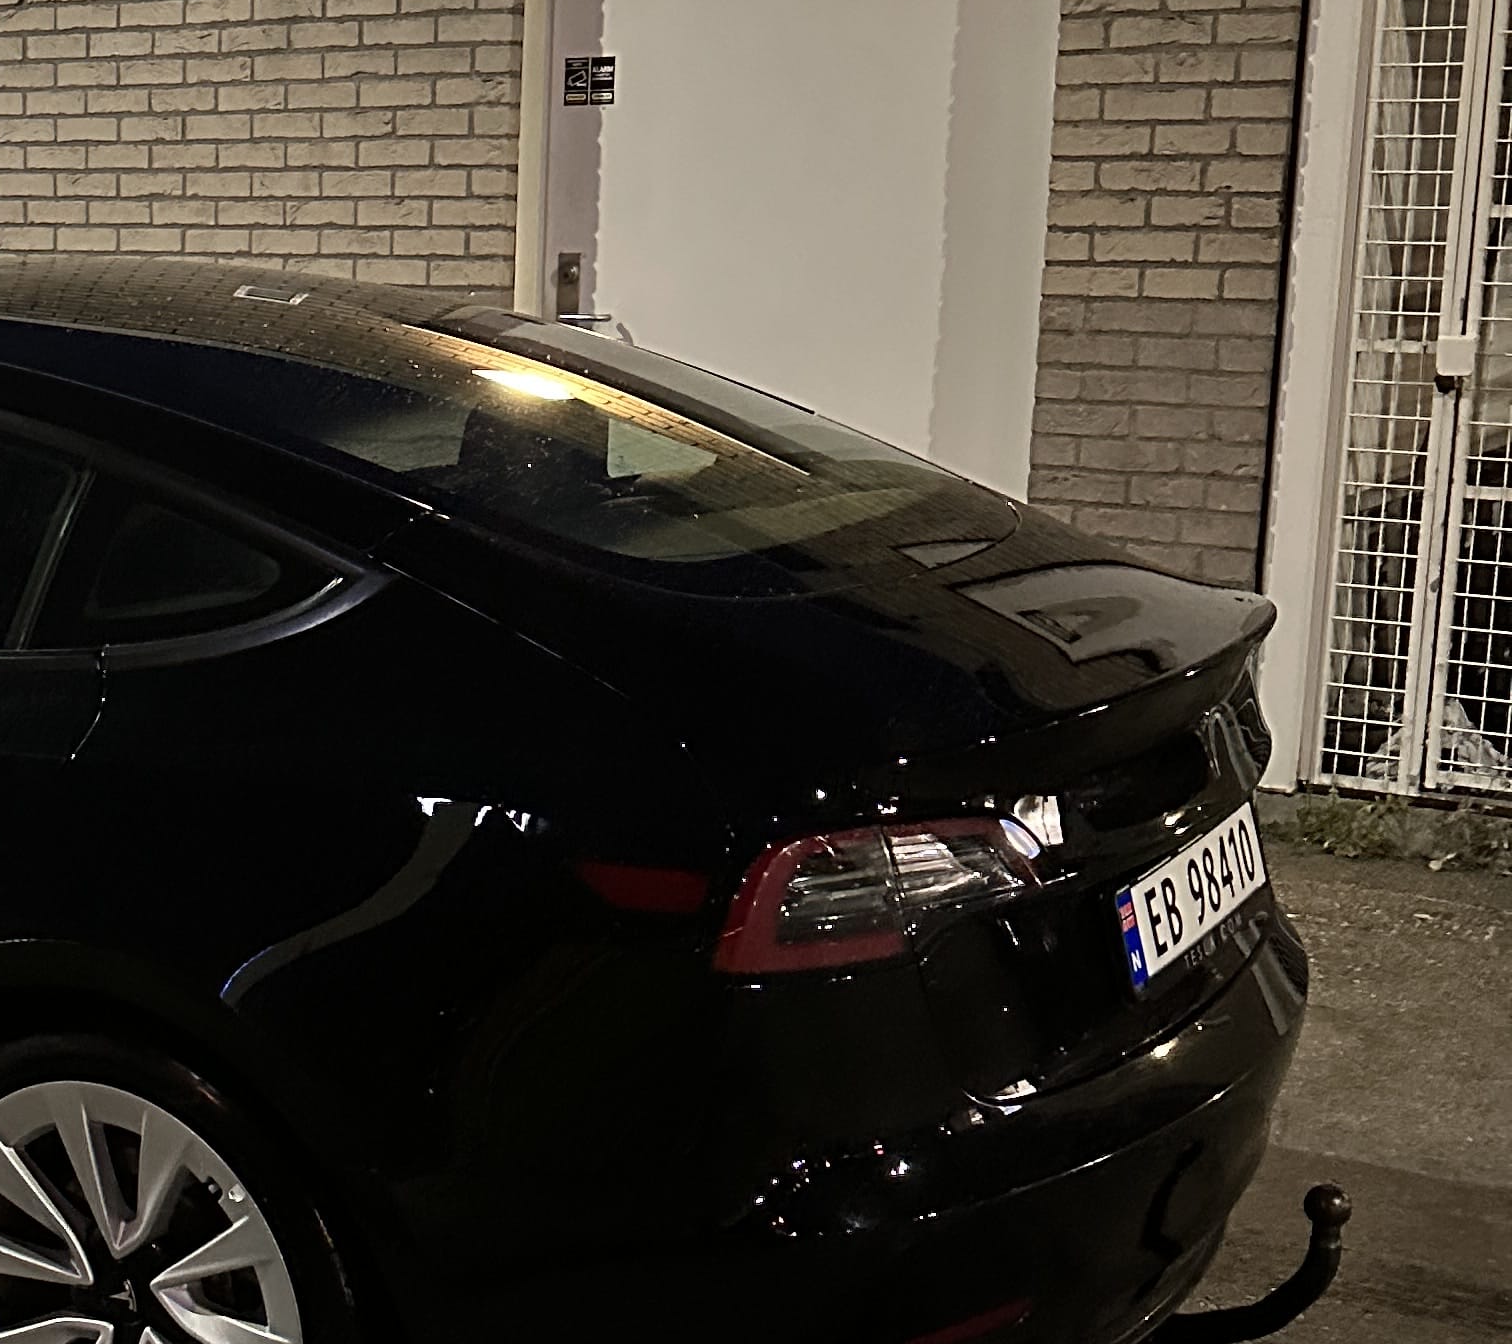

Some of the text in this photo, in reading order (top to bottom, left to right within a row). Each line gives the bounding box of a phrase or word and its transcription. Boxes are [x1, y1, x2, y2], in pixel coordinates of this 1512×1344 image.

[1144, 819, 1255, 958] EB 98410
[1130, 949, 1142, 972] N
